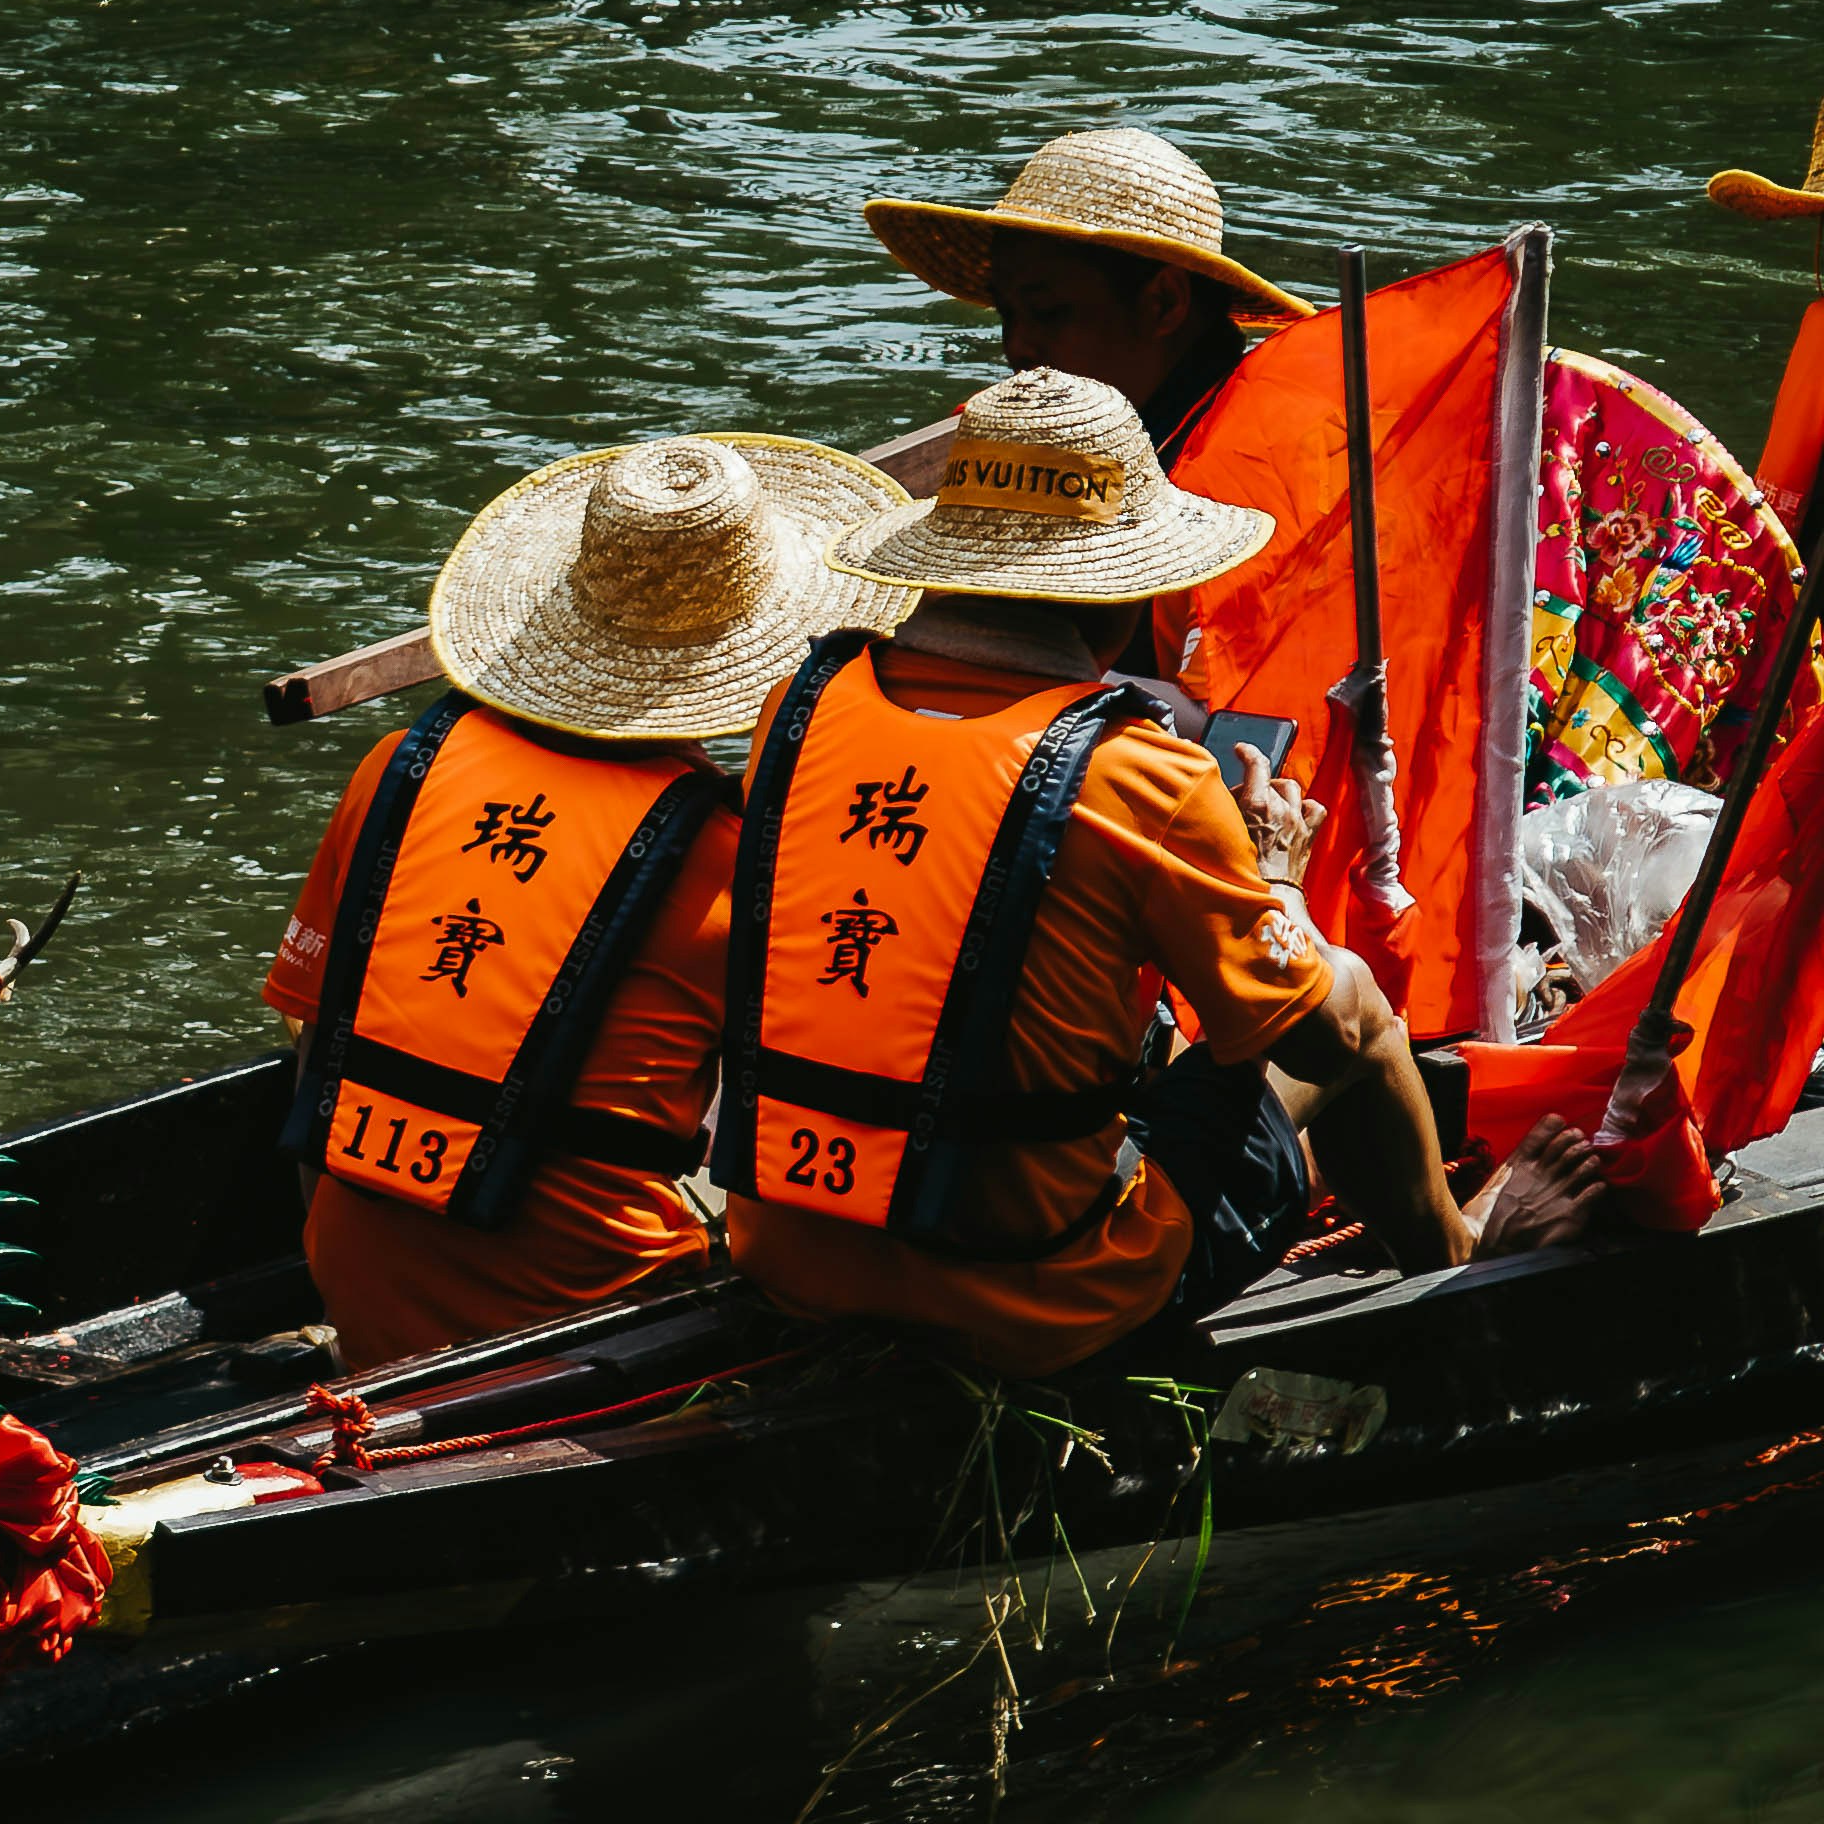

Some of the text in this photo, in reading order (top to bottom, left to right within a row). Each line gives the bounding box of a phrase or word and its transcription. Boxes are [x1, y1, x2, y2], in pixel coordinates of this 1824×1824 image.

[975, 460, 1108, 503] VUITTON
[427, 709, 458, 743] UST
[419, 792, 557, 999] 瑞寶
[816, 764, 930, 1000] 瑞寶
[341, 1103, 450, 1184] 113
[785, 1127, 857, 1195] 23
